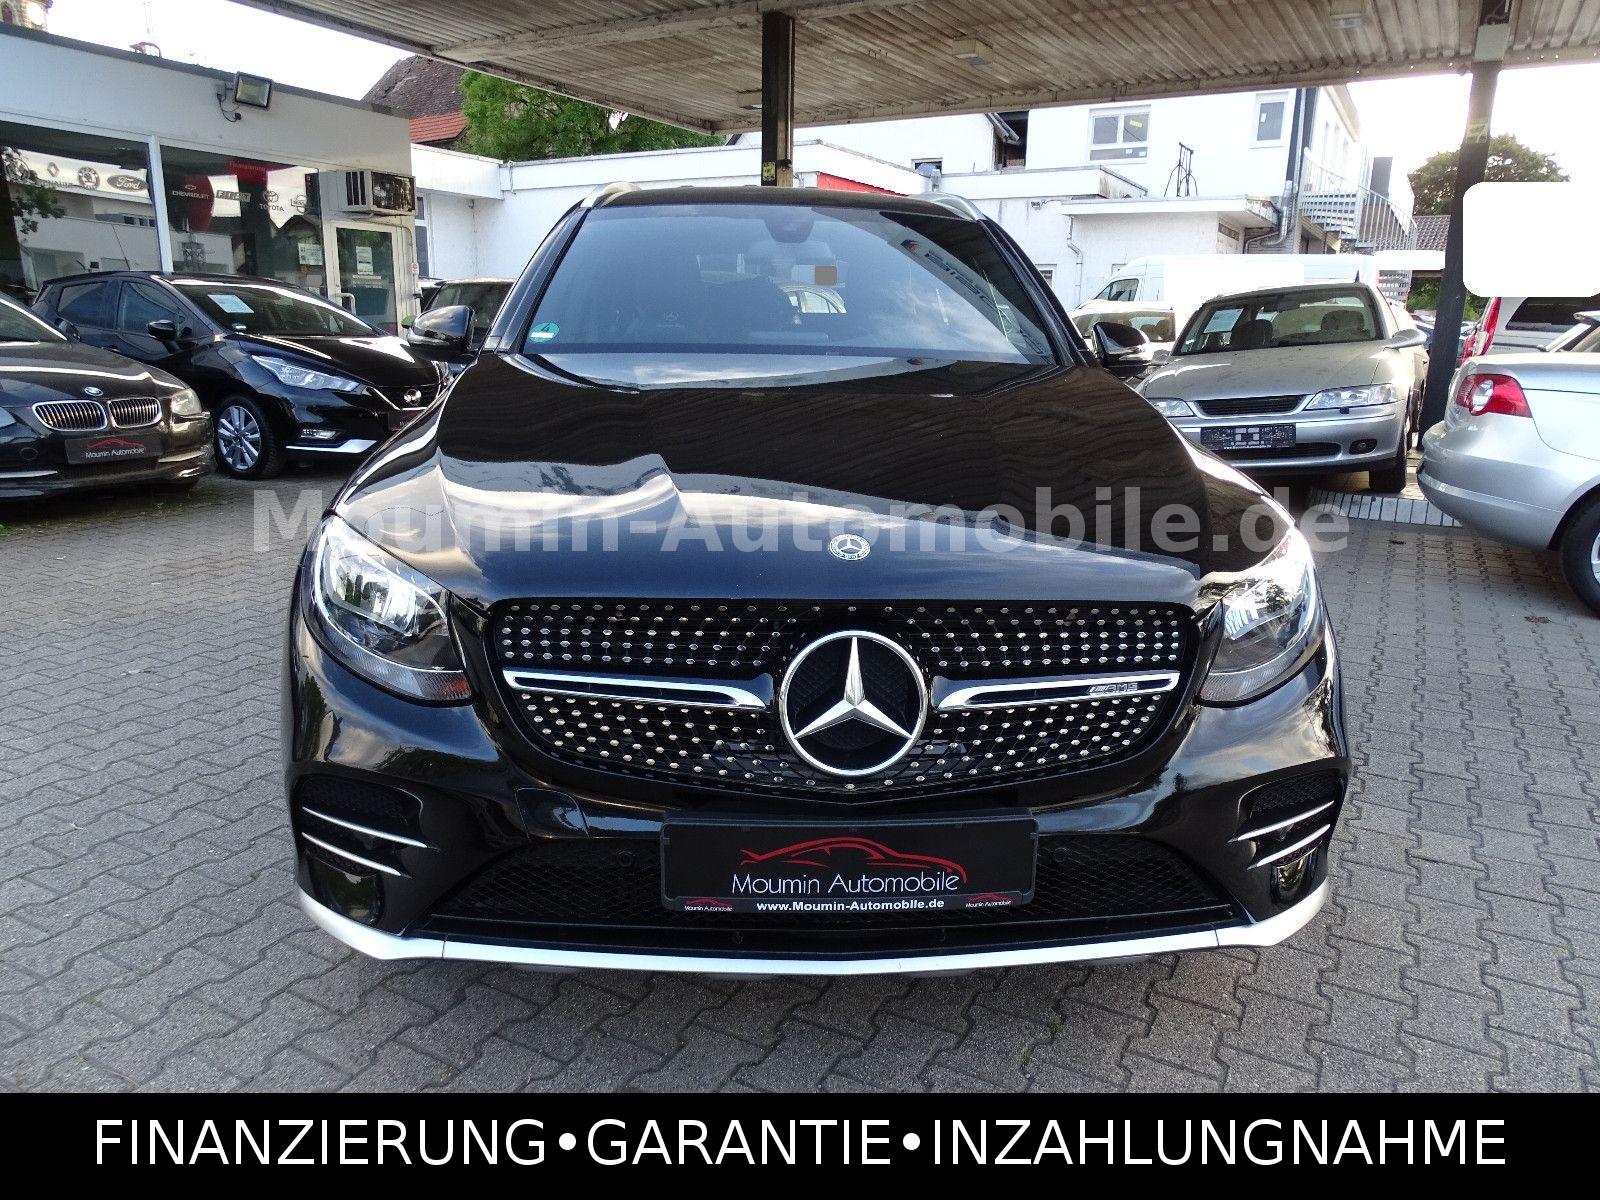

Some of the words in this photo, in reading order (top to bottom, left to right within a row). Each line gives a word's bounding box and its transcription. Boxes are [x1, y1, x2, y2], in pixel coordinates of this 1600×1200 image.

[116, 176, 140, 189] Ford
[172, 190, 210, 199] CHEVROLET
[216, 190, 251, 202] FIAT
[260, 203, 285, 212] TOYOTA
[732, 873, 820, 894] Moumin
[827, 870, 960, 894] Automobile
[756, 899, 945, 911] www.Moumin-Automobile.de
